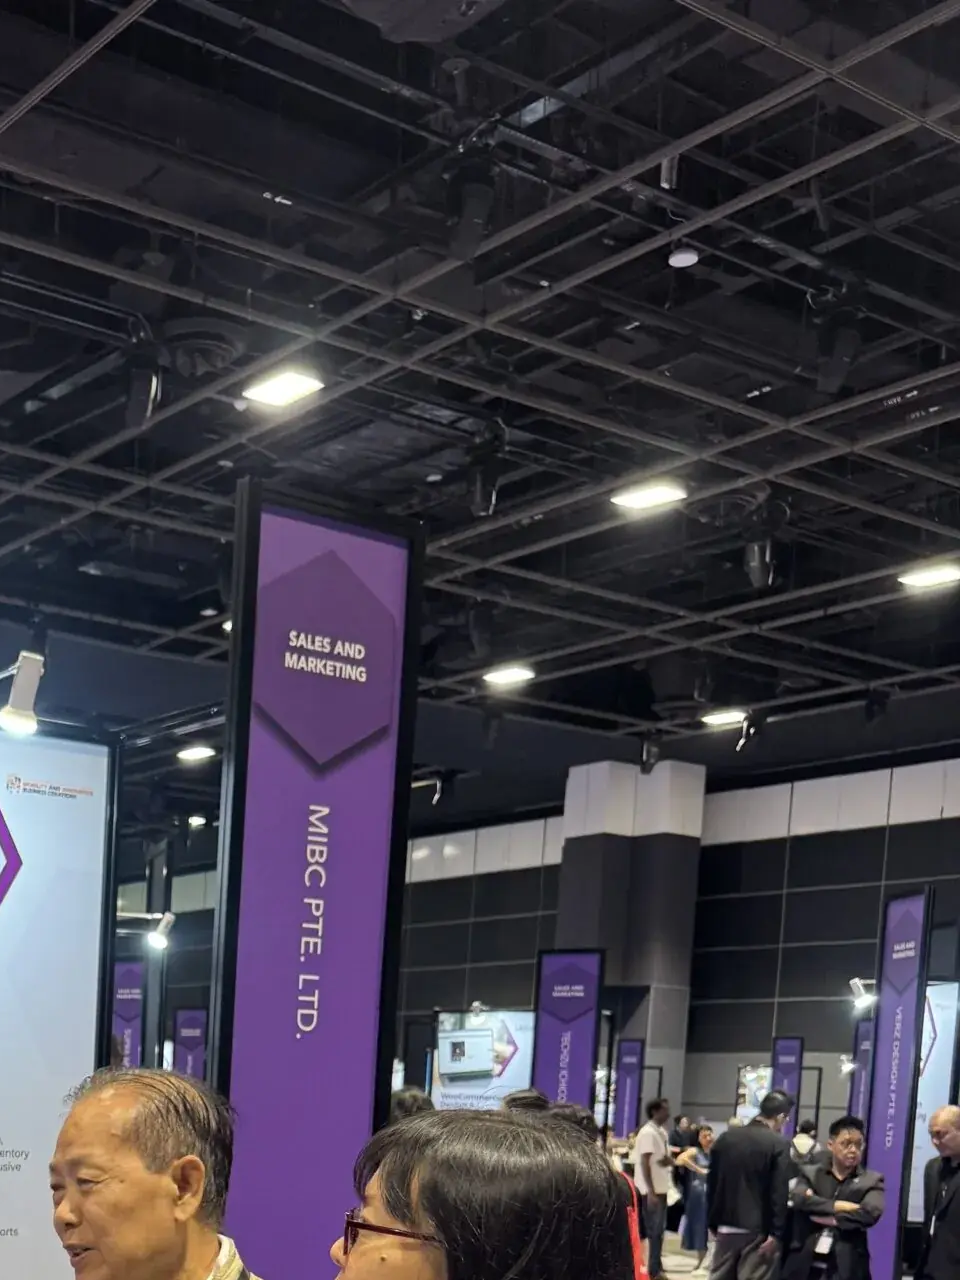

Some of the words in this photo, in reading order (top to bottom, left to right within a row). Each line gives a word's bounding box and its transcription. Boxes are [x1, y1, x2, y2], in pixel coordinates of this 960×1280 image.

[284, 652, 368, 682] MARKETING
[287, 630, 332, 654] SALES
[334, 639, 366, 660] AND
[303, 804, 330, 888] MIBC
[297, 897, 324, 963] PTE.
[294, 974, 320, 1040] LTD.
[889, 1040, 900, 1089] DESIGN
